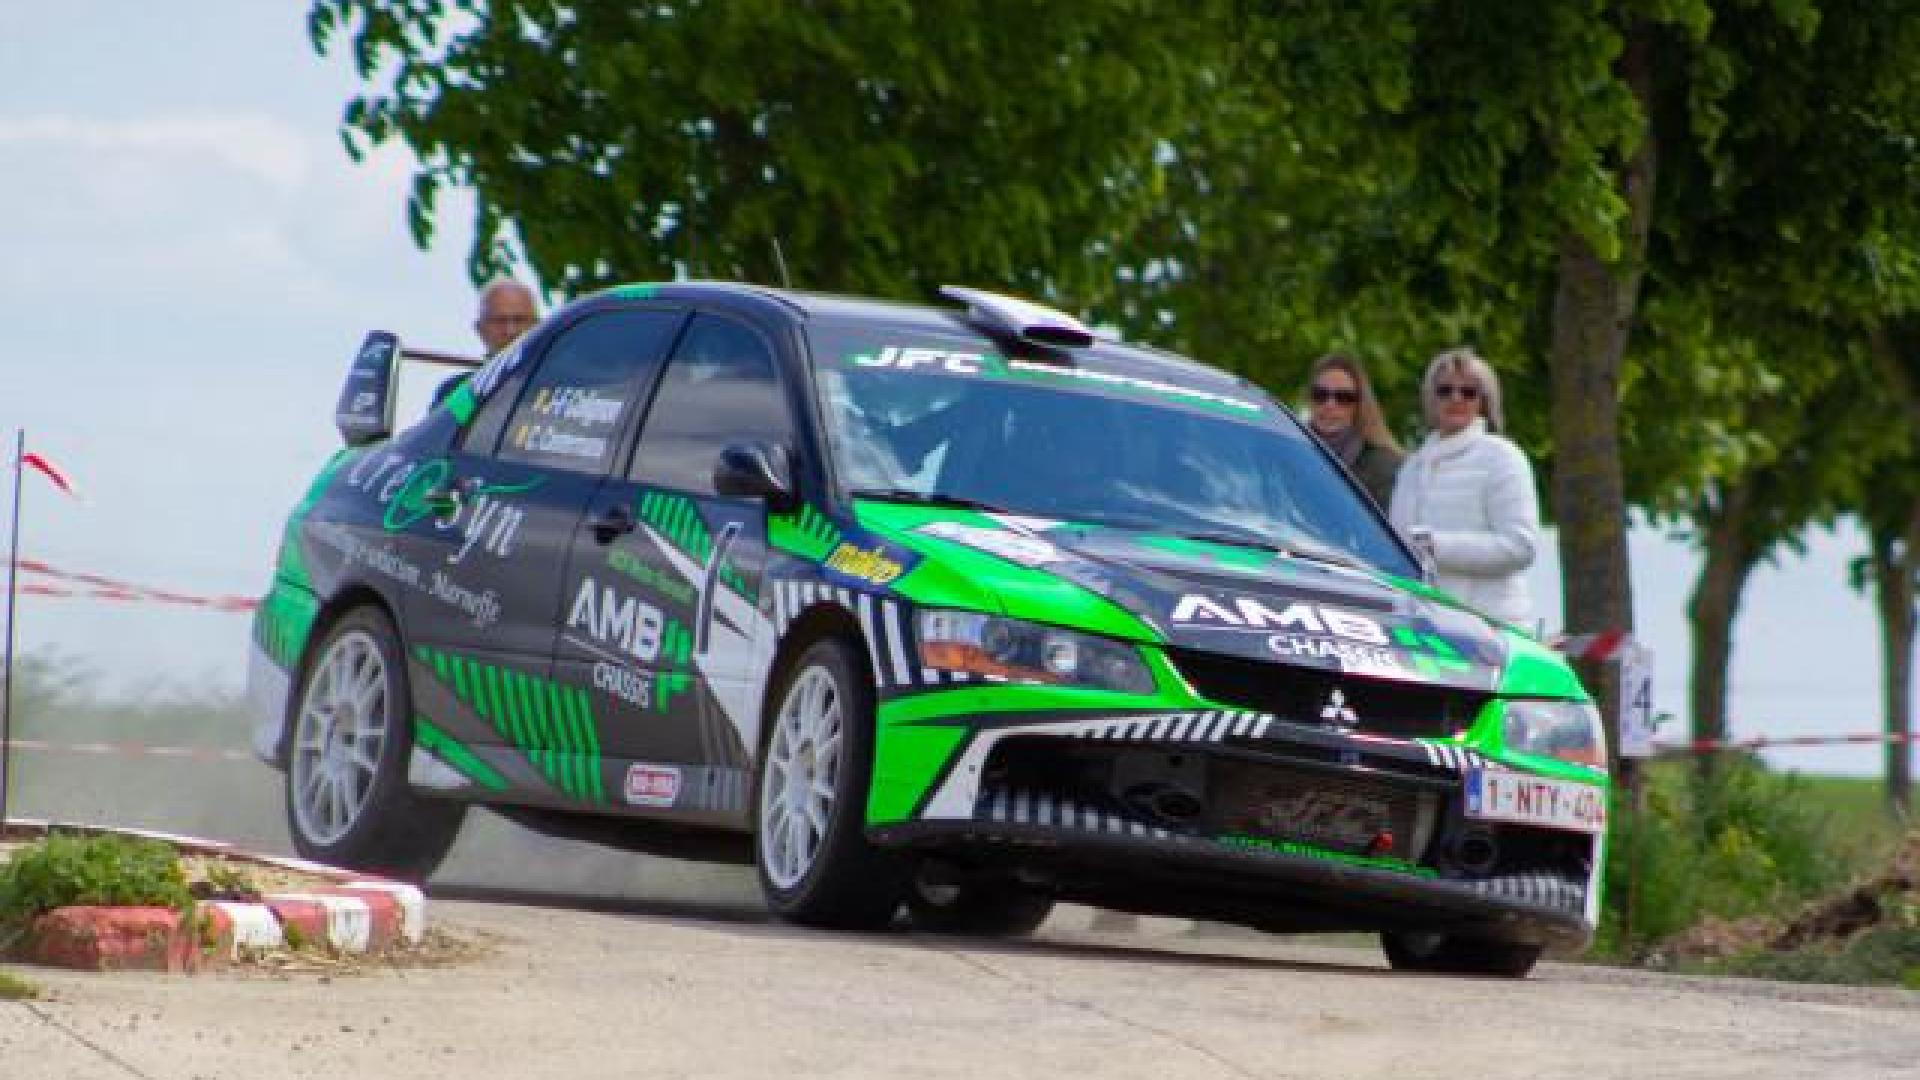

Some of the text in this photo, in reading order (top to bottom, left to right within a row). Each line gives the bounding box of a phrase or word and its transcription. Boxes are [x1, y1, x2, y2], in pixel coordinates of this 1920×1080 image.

[854, 347, 984, 373] JFC
[567, 576, 664, 662] AMB
[1171, 593, 1390, 645] AMB
[593, 661, 650, 710] CHASSIS
